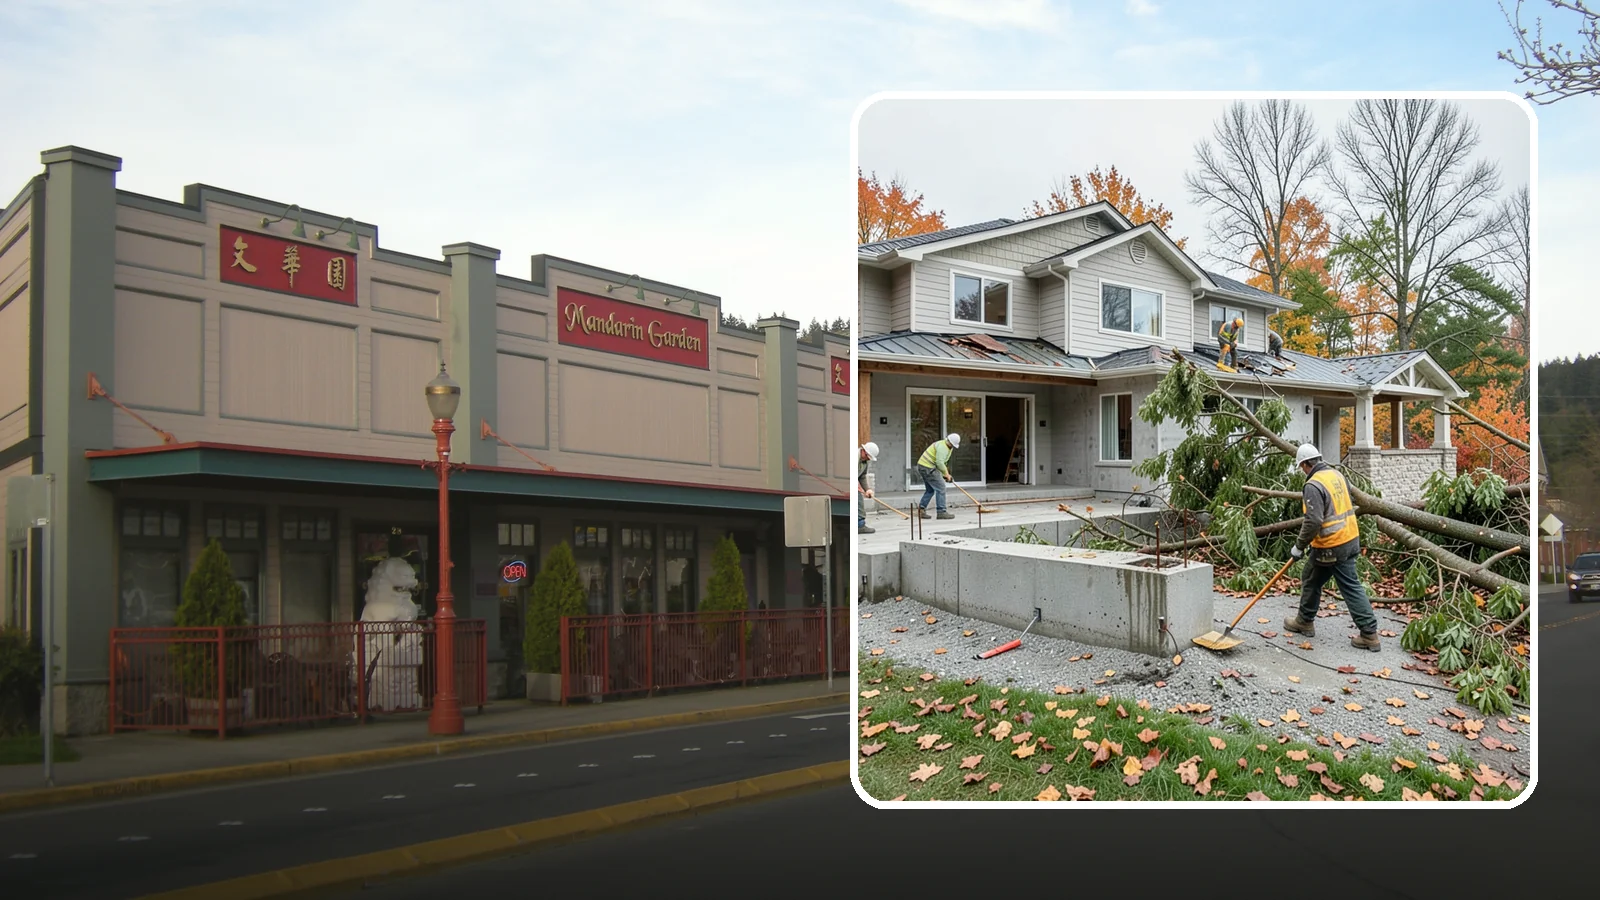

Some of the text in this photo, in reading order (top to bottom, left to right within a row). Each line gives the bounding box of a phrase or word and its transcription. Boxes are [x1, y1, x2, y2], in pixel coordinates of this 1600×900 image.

[565, 302, 701, 352] Mandarin Garden
[503, 565, 527, 578] OPEN
